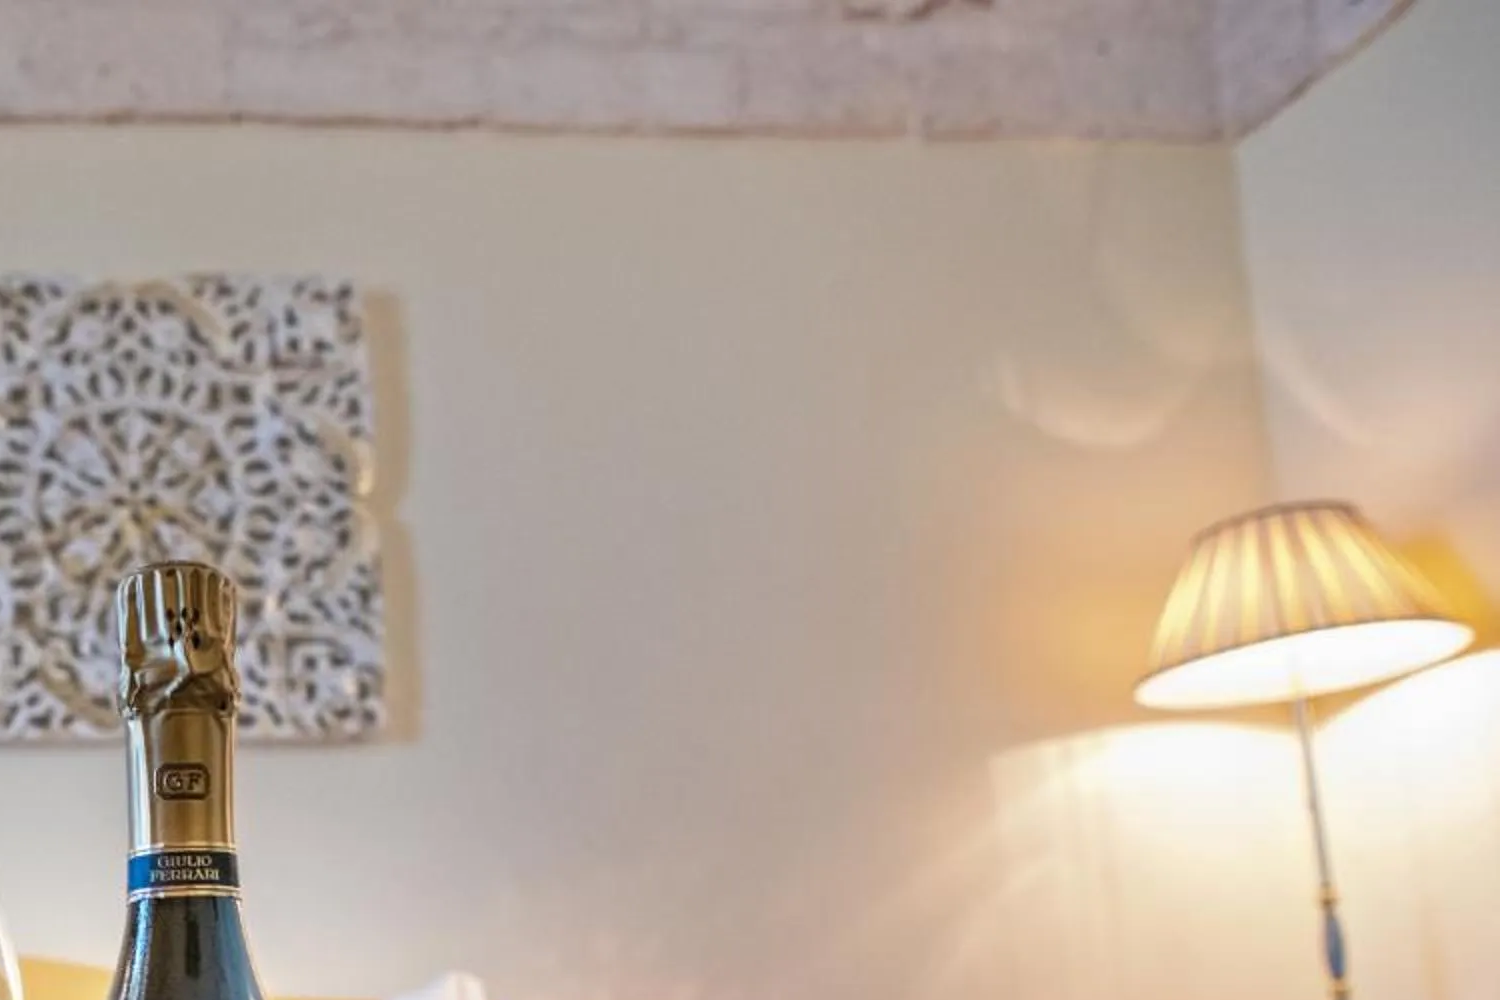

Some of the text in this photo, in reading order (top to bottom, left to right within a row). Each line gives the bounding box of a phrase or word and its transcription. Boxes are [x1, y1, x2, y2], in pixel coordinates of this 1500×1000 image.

[164, 771, 202, 792] GF
[157, 855, 212, 870] GIULIO
[150, 868, 220, 882] FERRARI
